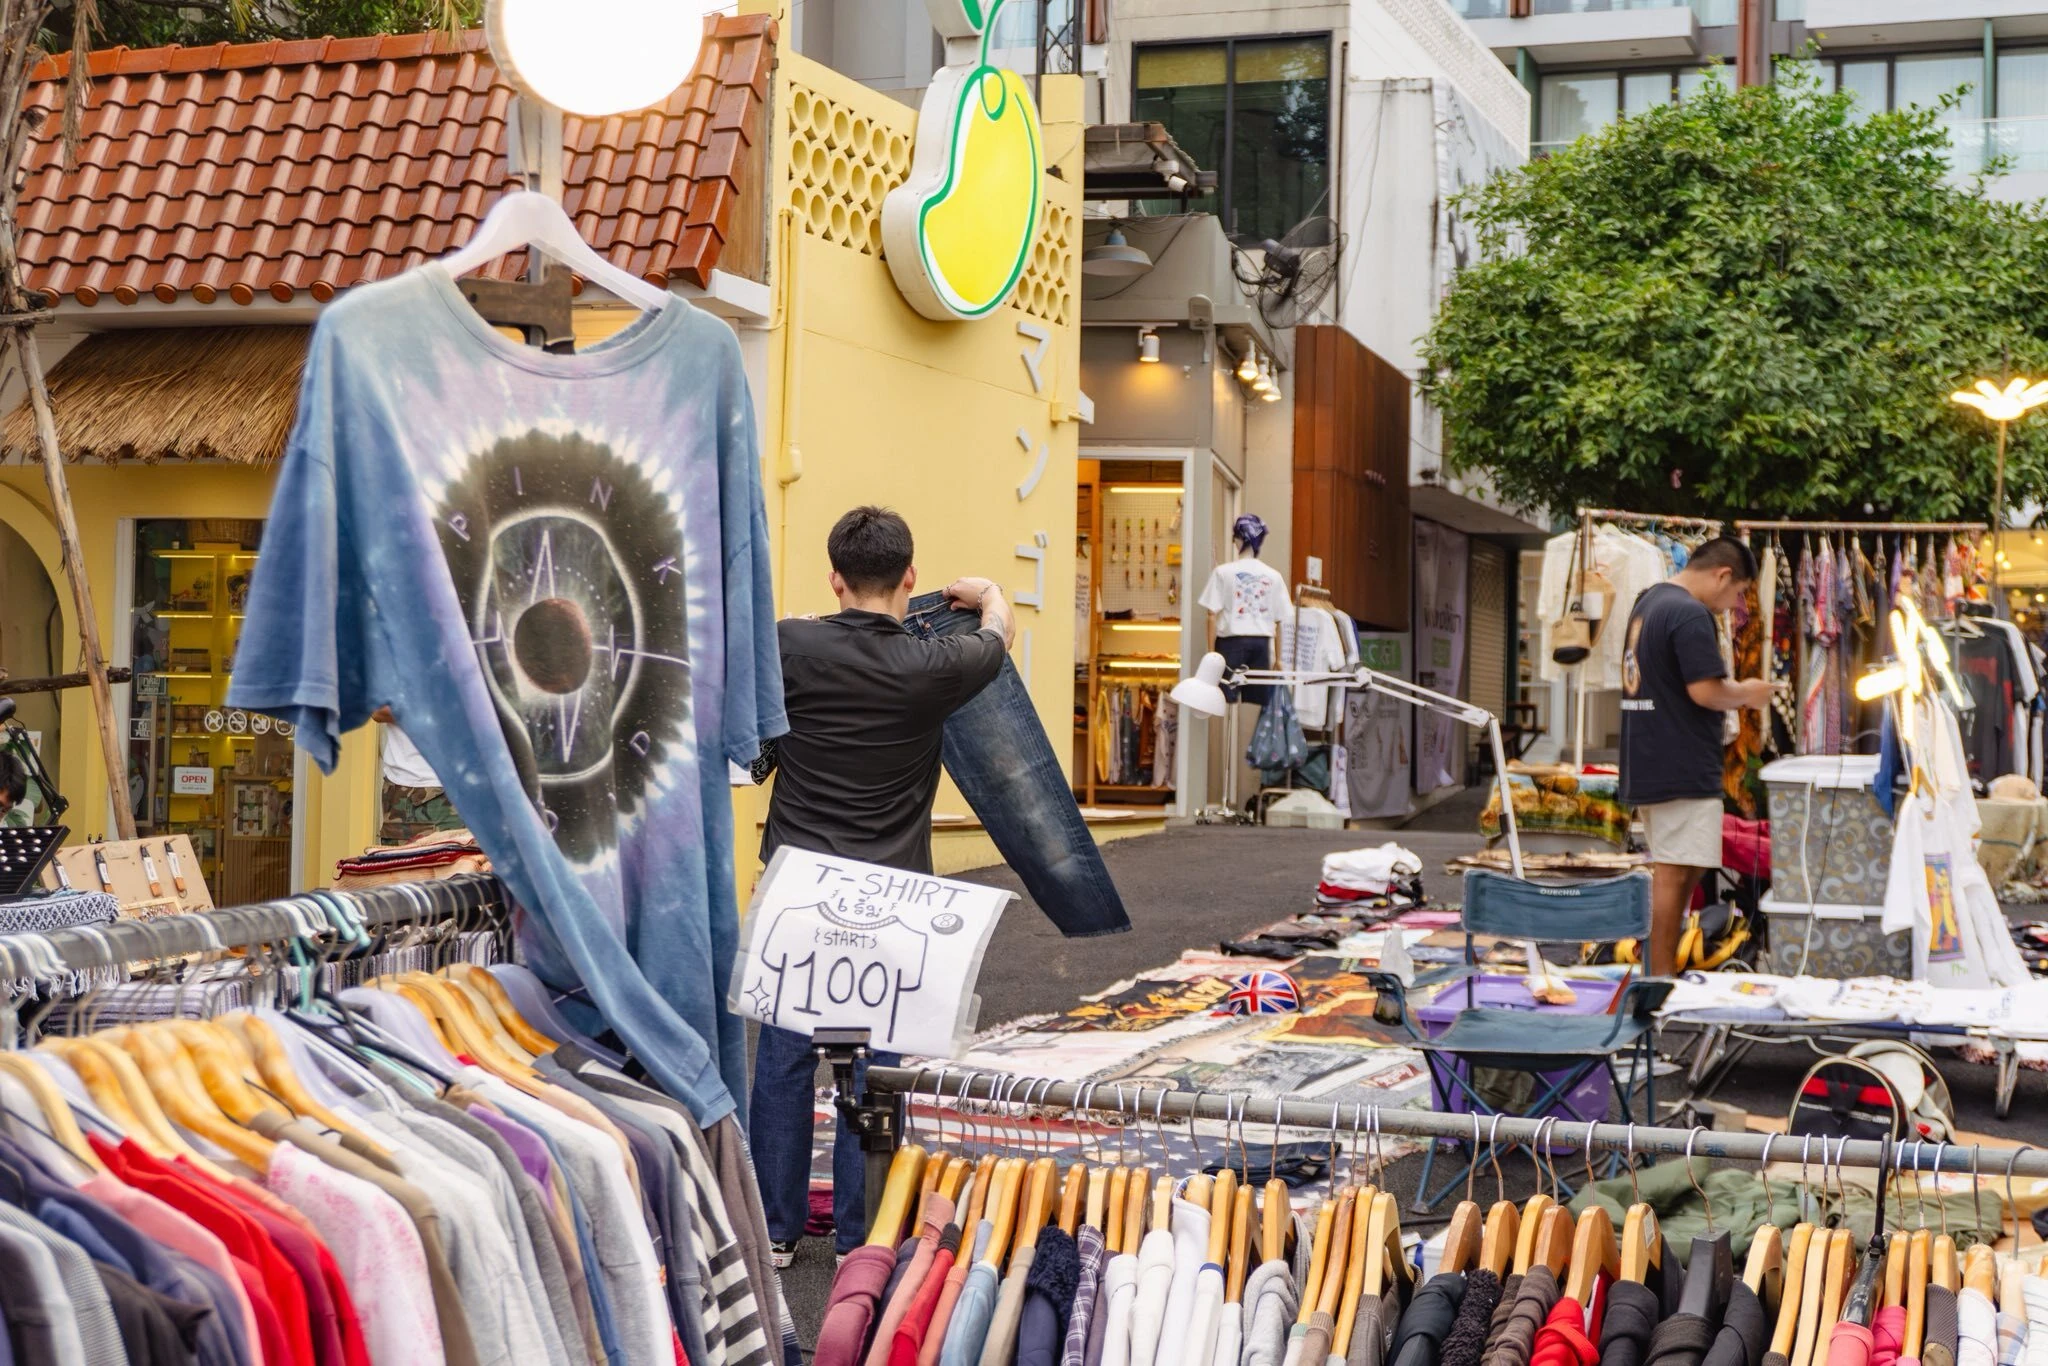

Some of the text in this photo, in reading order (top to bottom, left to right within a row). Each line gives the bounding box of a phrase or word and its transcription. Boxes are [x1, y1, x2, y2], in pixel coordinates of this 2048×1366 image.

[181, 775, 207, 784] OPEN
[816, 863, 970, 909] T-SHIRT
[792, 951, 890, 1016] 100
